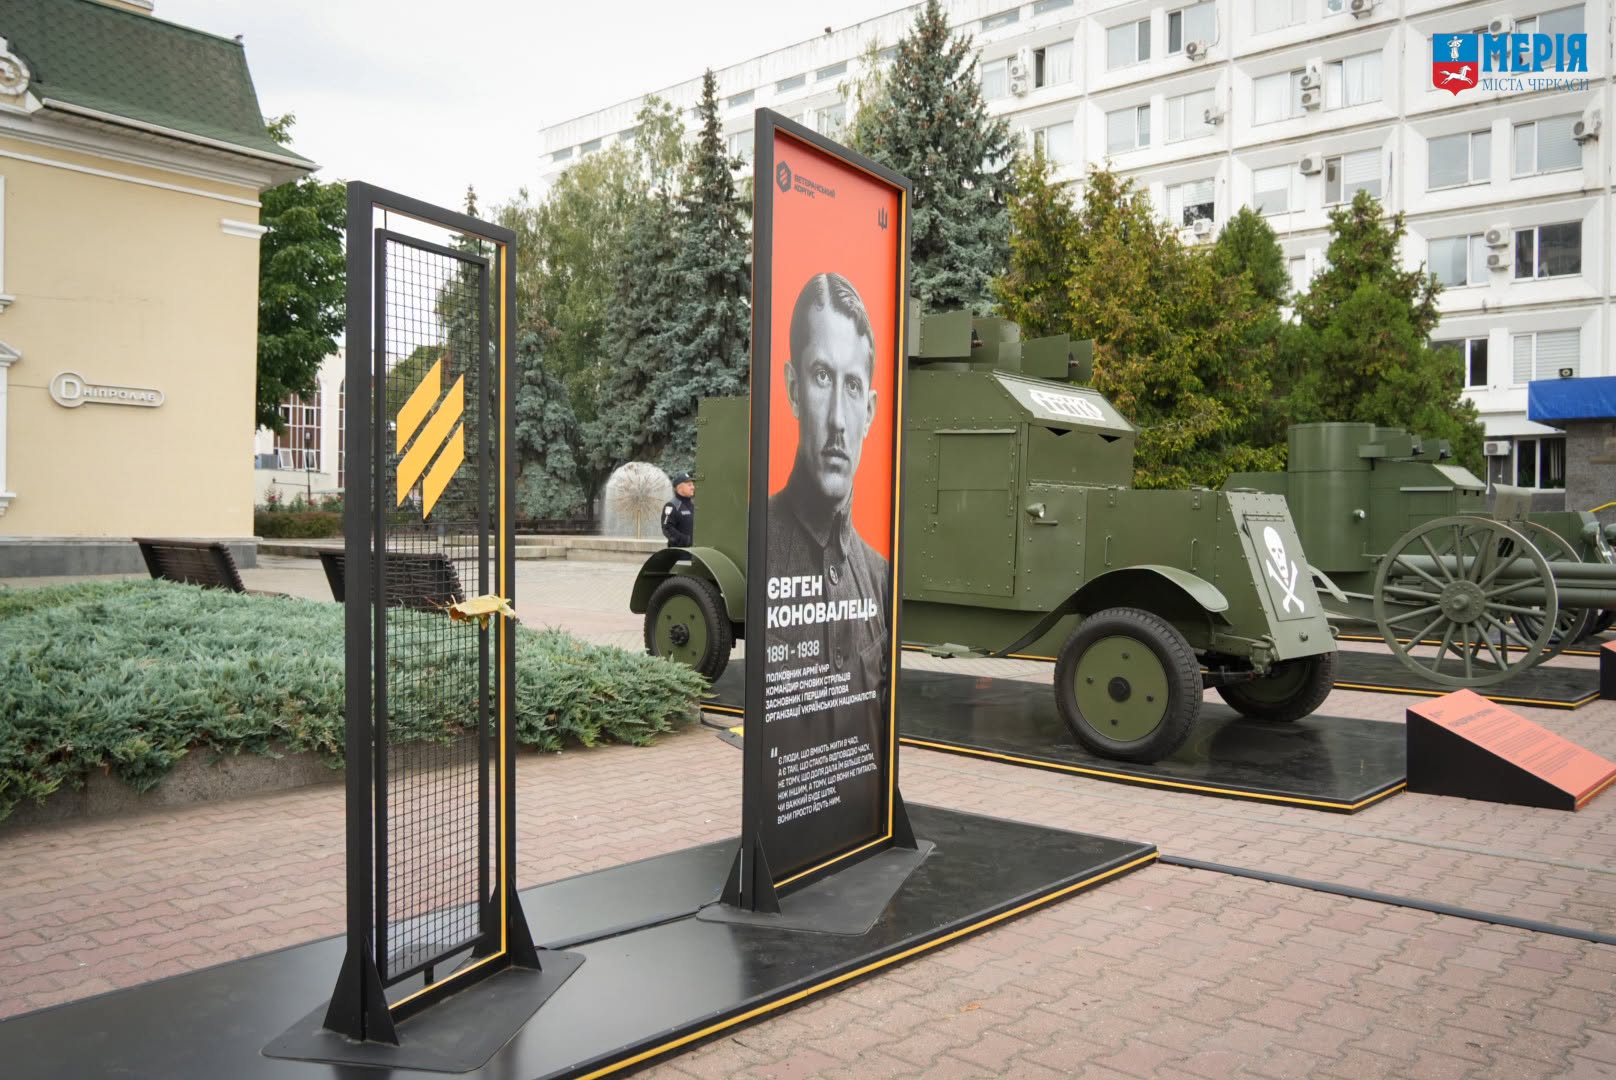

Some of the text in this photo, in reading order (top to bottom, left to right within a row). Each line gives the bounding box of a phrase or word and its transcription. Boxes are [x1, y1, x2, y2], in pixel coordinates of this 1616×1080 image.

[794, 184, 815, 199] КОРПУС
[767, 575, 823, 600] ЄВГЕН
[767, 598, 878, 629] КОНОВАЛЕЦЬ
[767, 644, 789, 663] 1891
[797, 640, 820, 658] 1938
[766, 663, 830, 683] ПОЛКОВНИК АРМІЇ УНР
[765, 672, 851, 696] КОМАНДИР СІЧОВИХ СТРІЛЬЦІВ
[765, 695, 801, 710] ЗАСНОВНИК
[803, 687, 828, 702] ПЕРШИЙ
[828, 684, 849, 697] ГОЛОВА
[765, 690, 877, 723] ОРГАНІЗАЦІЇ УКРАЇНСЬКИХ НАЦІОНАЛІСТІВ
[801, 749, 810, 759] ЩО
[800, 761, 809, 771] ЩО
[778, 780, 785, 789] НЕ
[801, 772, 810, 782] ЩО
[827, 775, 836, 784] ЩО
[836, 770, 849, 782] ВОНИ
[778, 803, 785, 812] ЧИ
[785, 794, 807, 810] ВАЖКИЙ
[778, 812, 793, 824] ВОНИ
[792, 805, 813, 819] ПРОСТО
